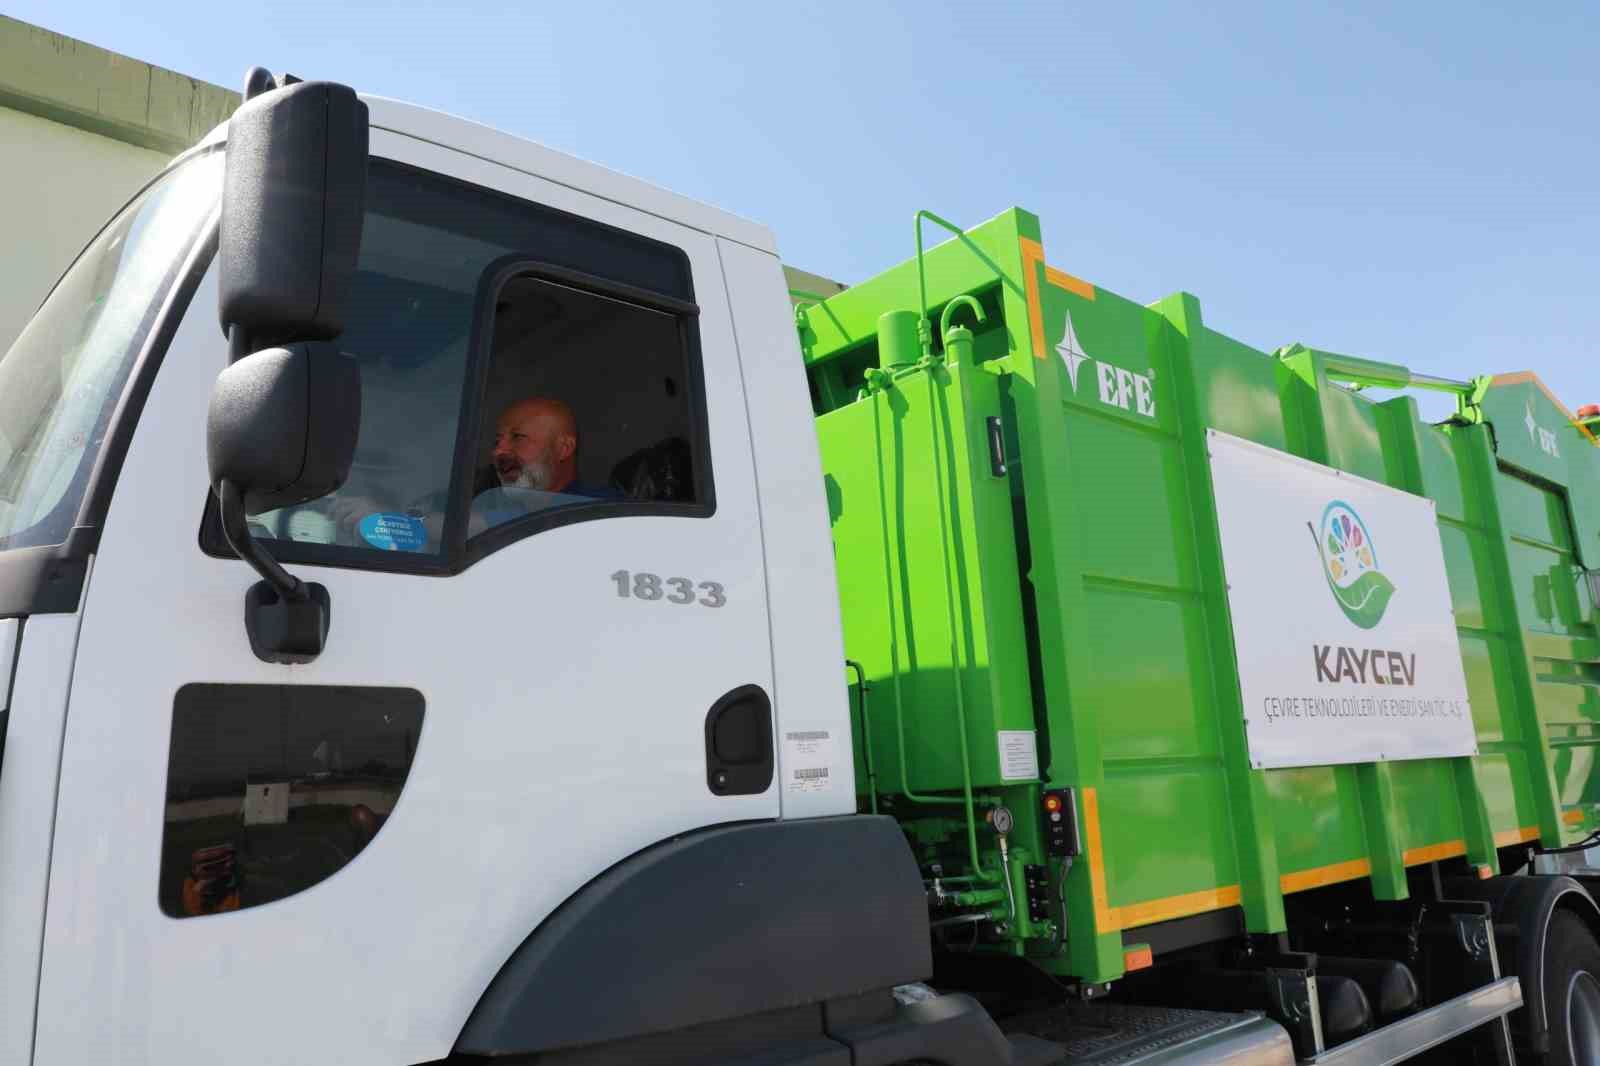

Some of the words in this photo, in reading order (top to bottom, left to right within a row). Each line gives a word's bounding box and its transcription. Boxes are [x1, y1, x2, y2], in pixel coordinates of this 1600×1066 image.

[1096, 361, 1154, 418] EFE
[611, 569, 727, 609] 1833
[1264, 697, 1301, 724] ÇEVRE
